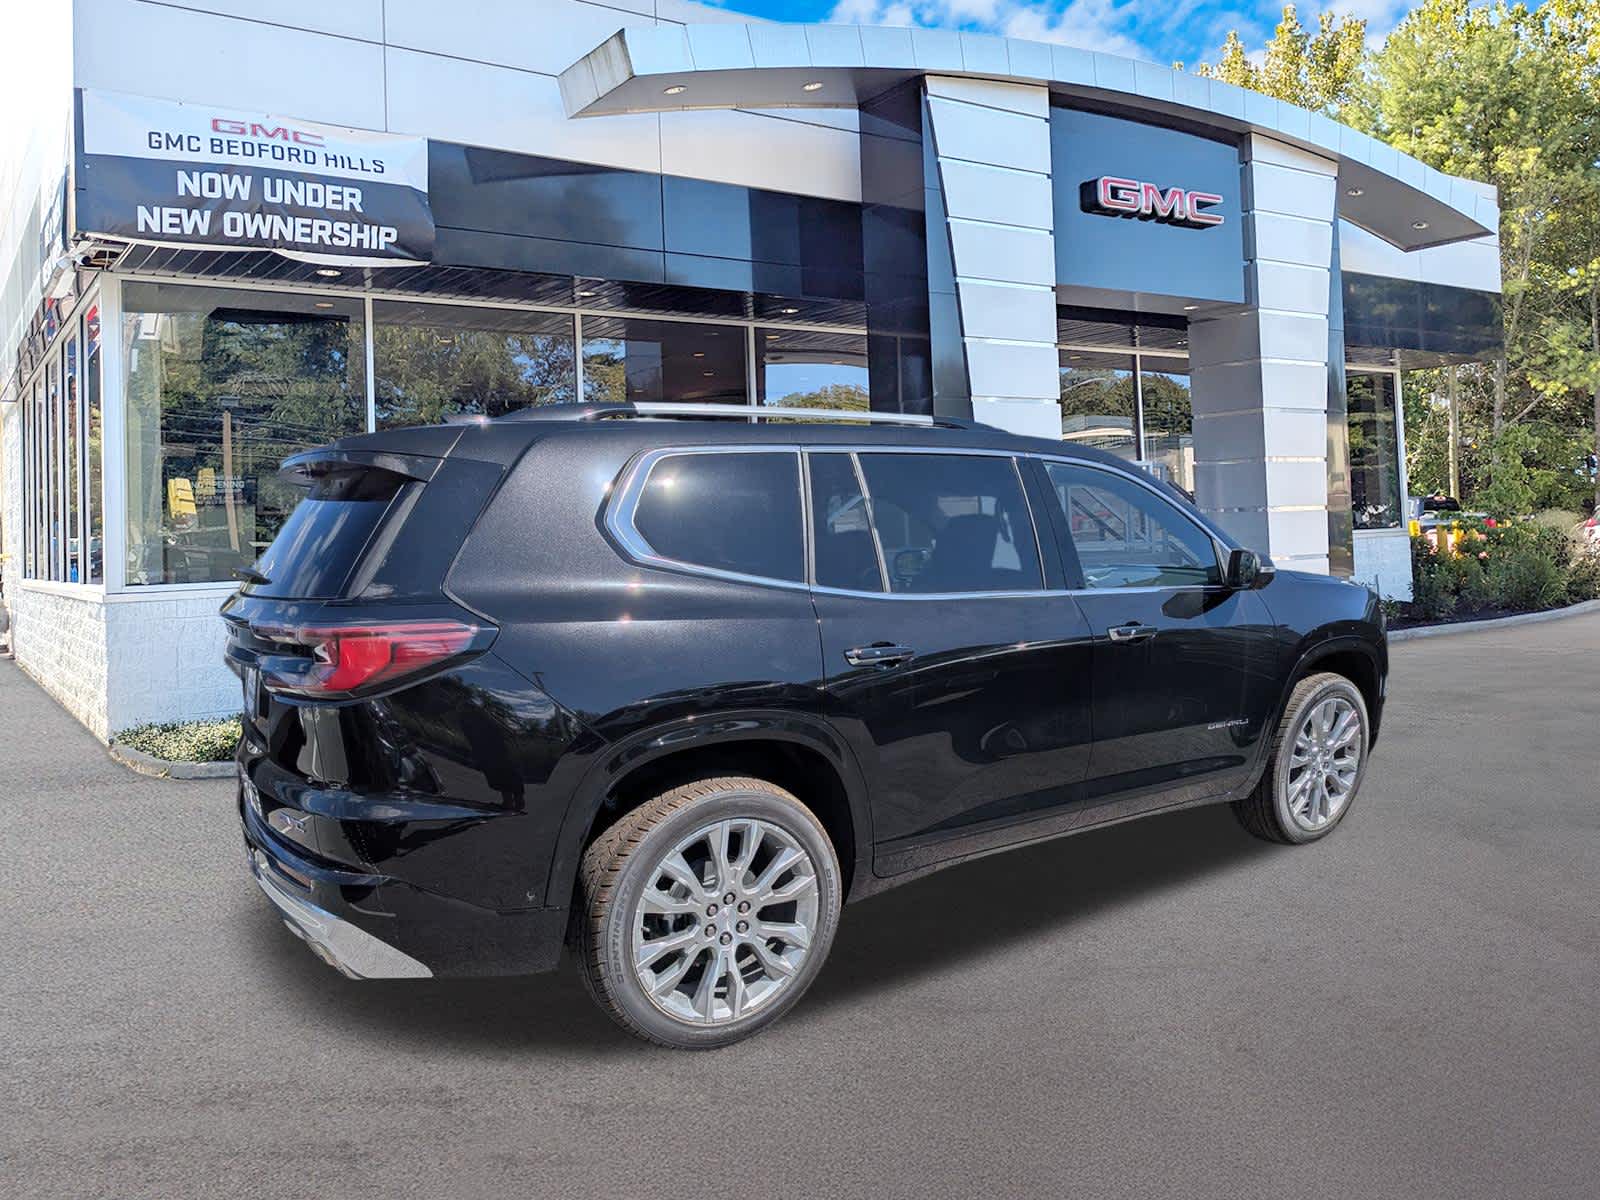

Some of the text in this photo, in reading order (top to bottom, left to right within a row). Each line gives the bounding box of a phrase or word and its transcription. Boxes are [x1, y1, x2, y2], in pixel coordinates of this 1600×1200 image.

[148, 132, 385, 174] GMC BEDFORD HILLS
[211, 118, 325, 147] GMC
[177, 171, 363, 212] NOW UNDER
[1098, 176, 1224, 224] GMC
[137, 206, 398, 250] NEW OWNERSHIP
